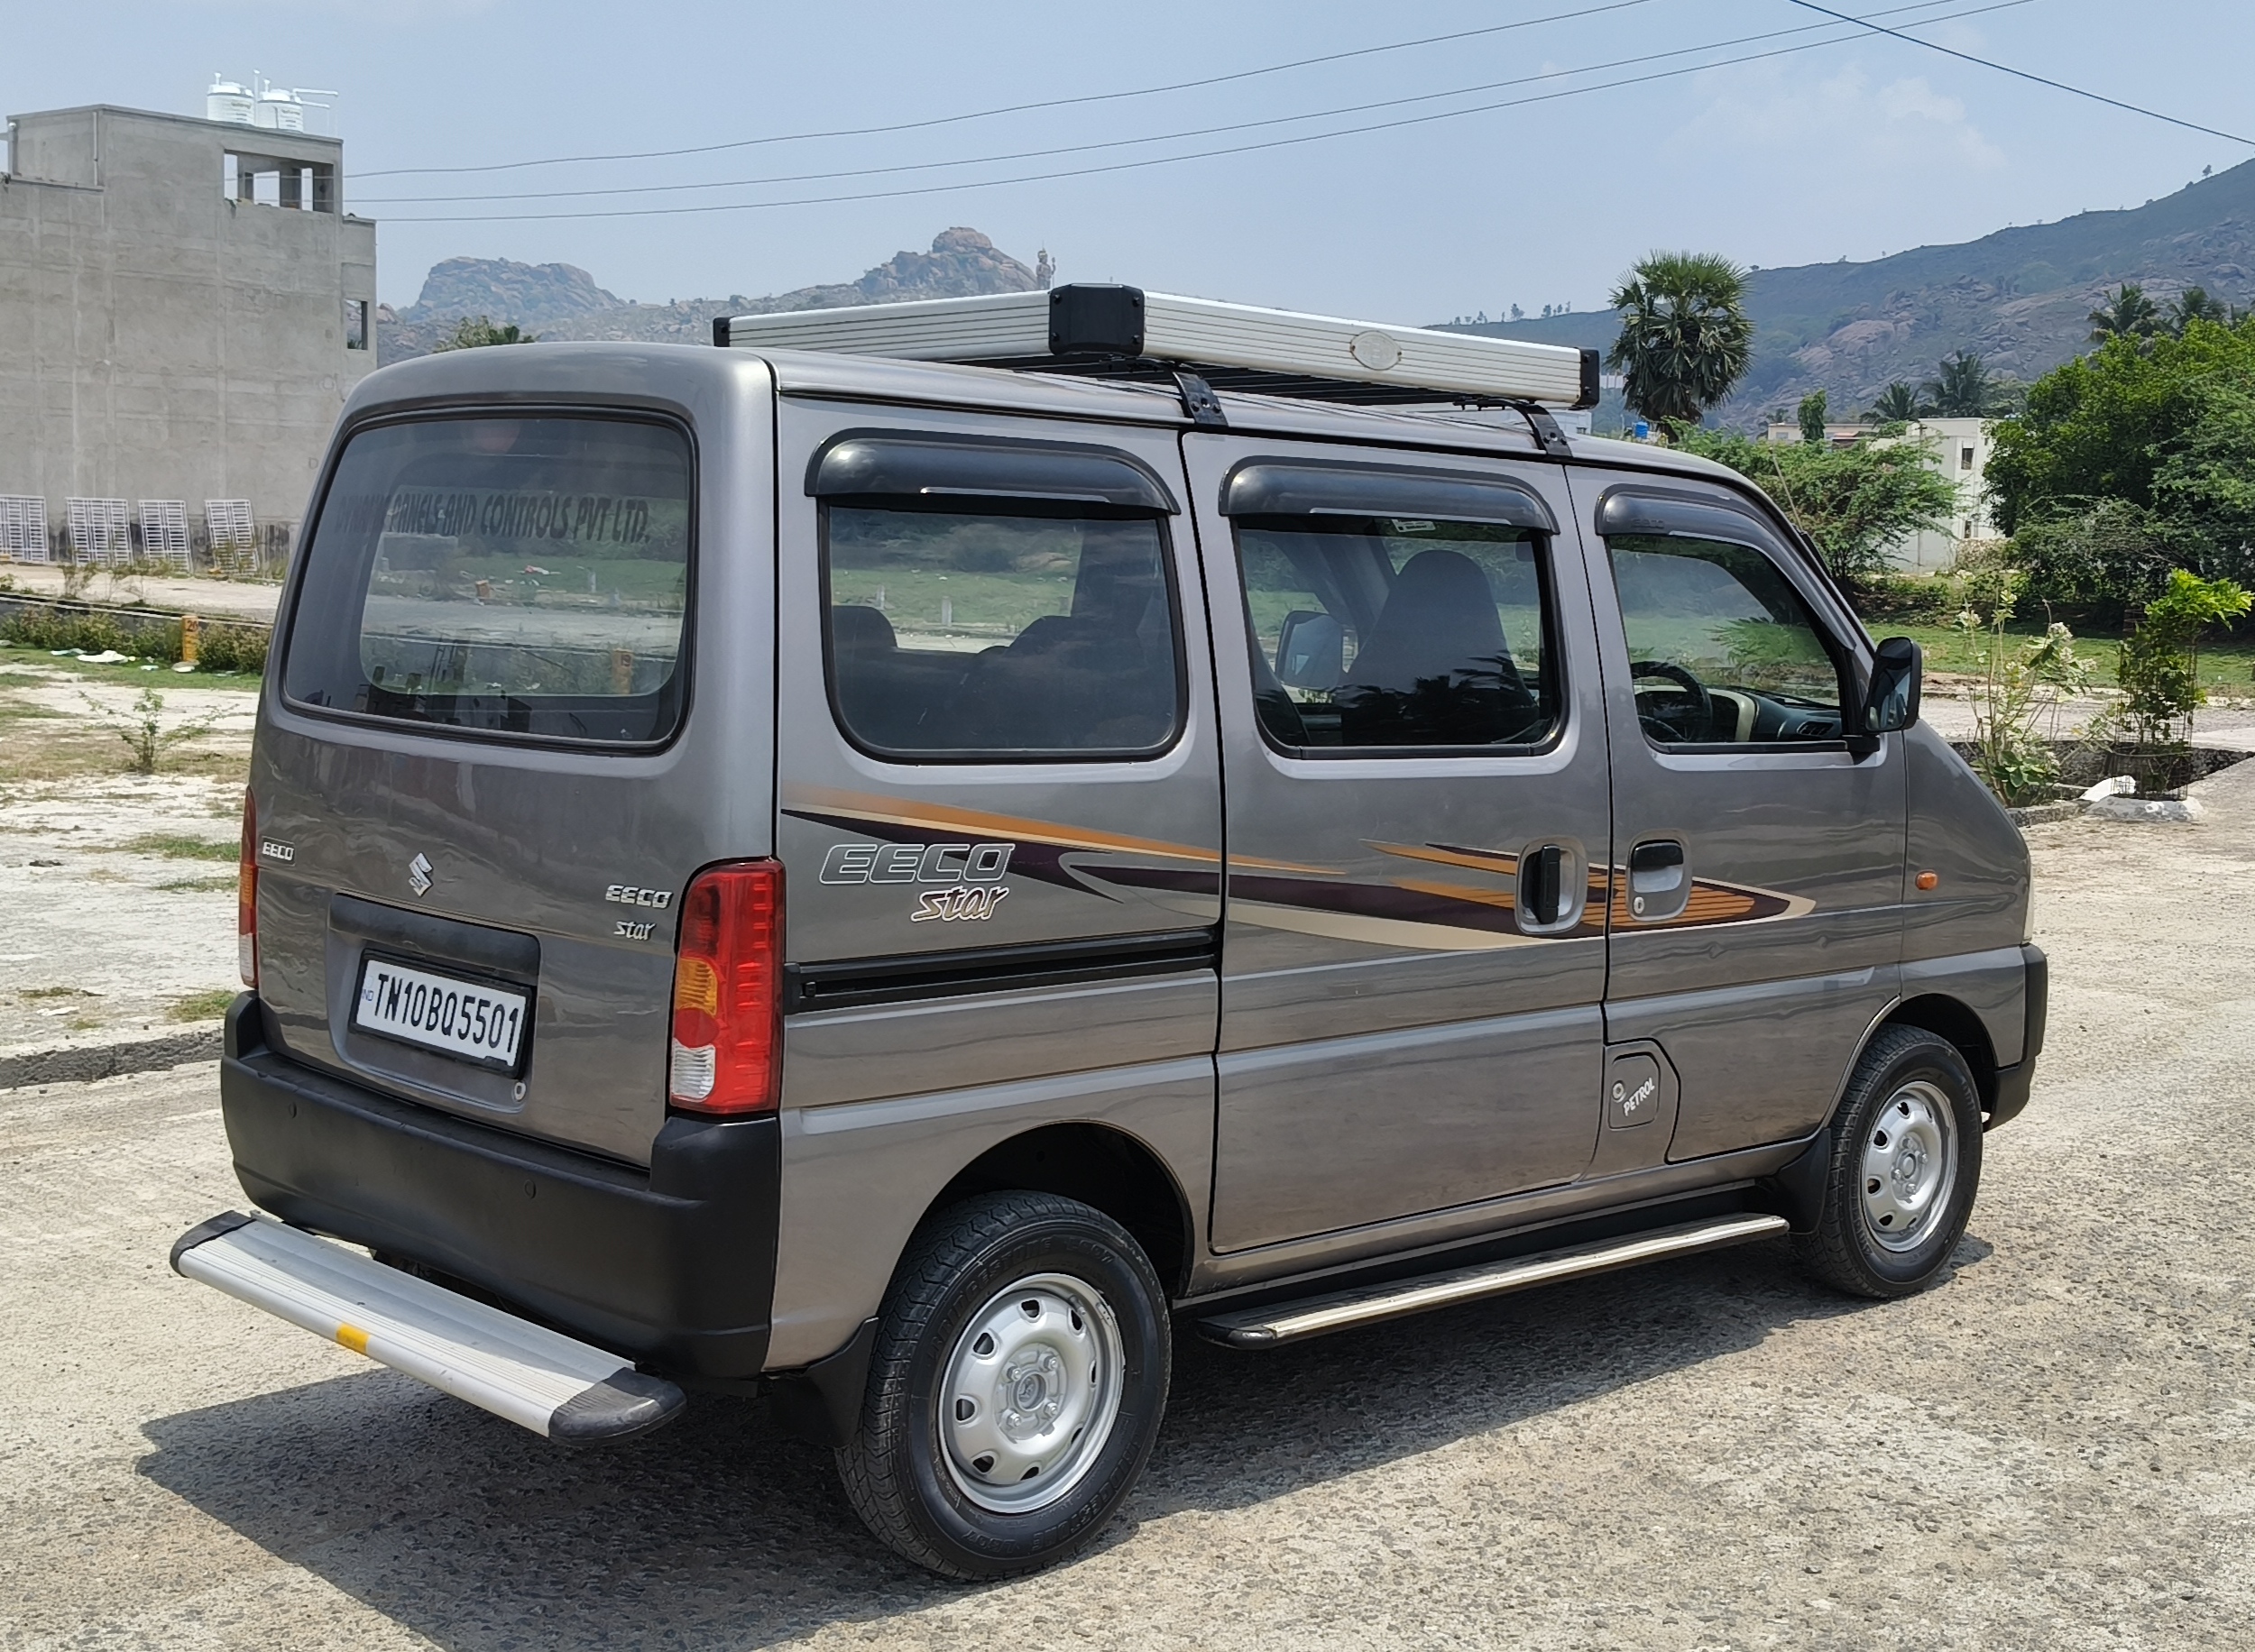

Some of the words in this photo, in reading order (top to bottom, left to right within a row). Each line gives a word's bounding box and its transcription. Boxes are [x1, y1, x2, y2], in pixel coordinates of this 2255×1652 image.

[481, 494, 572, 538] CONTROLS
[262, 841, 294, 861] EECO
[819, 843, 1016, 885] EECO
[605, 885, 673, 909] EECO
[910, 886, 1009, 922] star
[613, 920, 657, 941] star
[374, 973, 519, 1053] TN10BQ5501
[1623, 1077, 1655, 1116] PETROL
